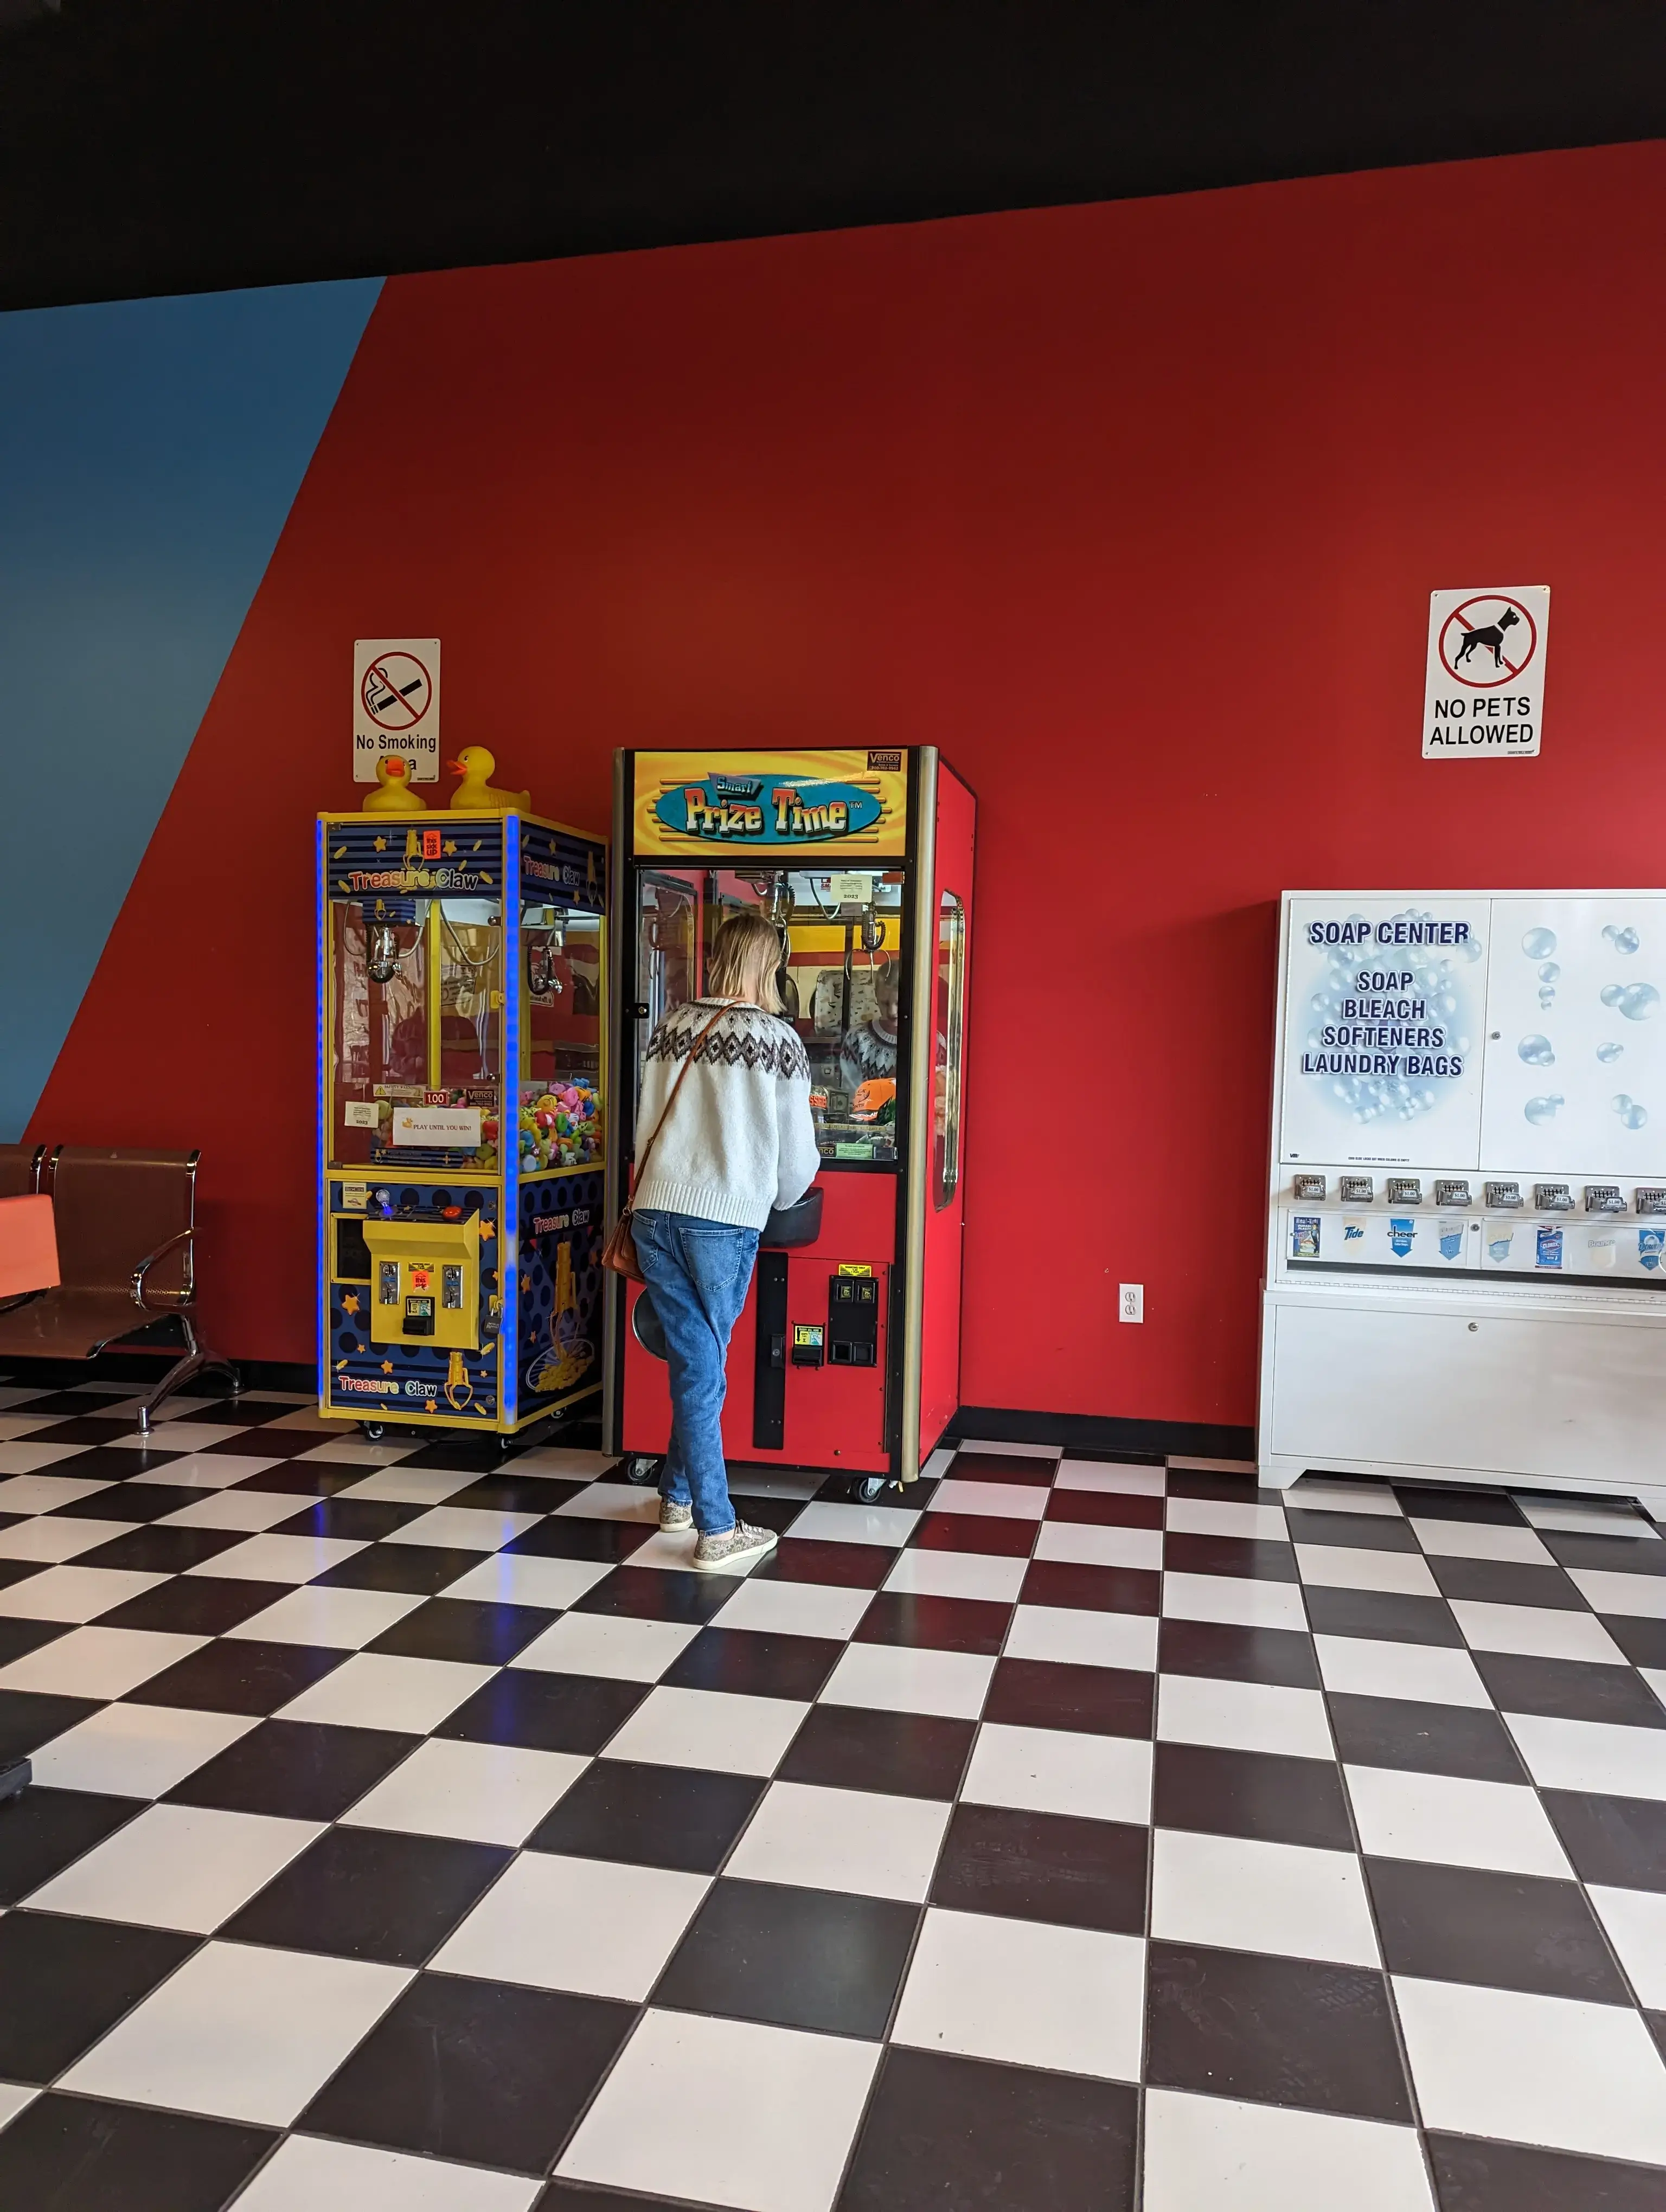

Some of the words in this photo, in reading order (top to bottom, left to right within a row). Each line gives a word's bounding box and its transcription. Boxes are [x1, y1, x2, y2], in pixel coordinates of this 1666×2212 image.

[1434, 699, 1465, 718] NO
[1473, 697, 1530, 717] PETS
[356, 735, 374, 749] No
[379, 734, 436, 753] Smoking
[1430, 724, 1534, 745] ALLOWED
[870, 753, 900, 763] Venco
[716, 776, 753, 794] Smart
[684, 787, 762, 834] Prize
[772, 787, 848, 834] Time
[348, 869, 430, 891] Treasure
[435, 868, 479, 890] Claw
[523, 855, 560, 882] Treasure
[562, 865, 580, 886] Claw
[1310, 922, 1372, 943] SOAP
[1377, 922, 1470, 944] CENTER
[1358, 971, 1414, 991] SOAP
[1344, 999, 1426, 1019] BLEACH
[1324, 1026, 1445, 1047] SOFTENERS
[1304, 1053, 1400, 1074] LAUNDRY
[1408, 1056, 1464, 1076] BAGS
[427, 1094, 444, 1103] 1.00
[468, 1091, 493, 1099] Venco
[534, 1214, 569, 1234] Treasure
[572, 1208, 590, 1226] Claw
[1387, 1225, 1418, 1238] cheer
[1344, 1226, 1364, 1240] Tide
[338, 1375, 399, 1394] Treasure
[405, 1380, 438, 1397] Claw
